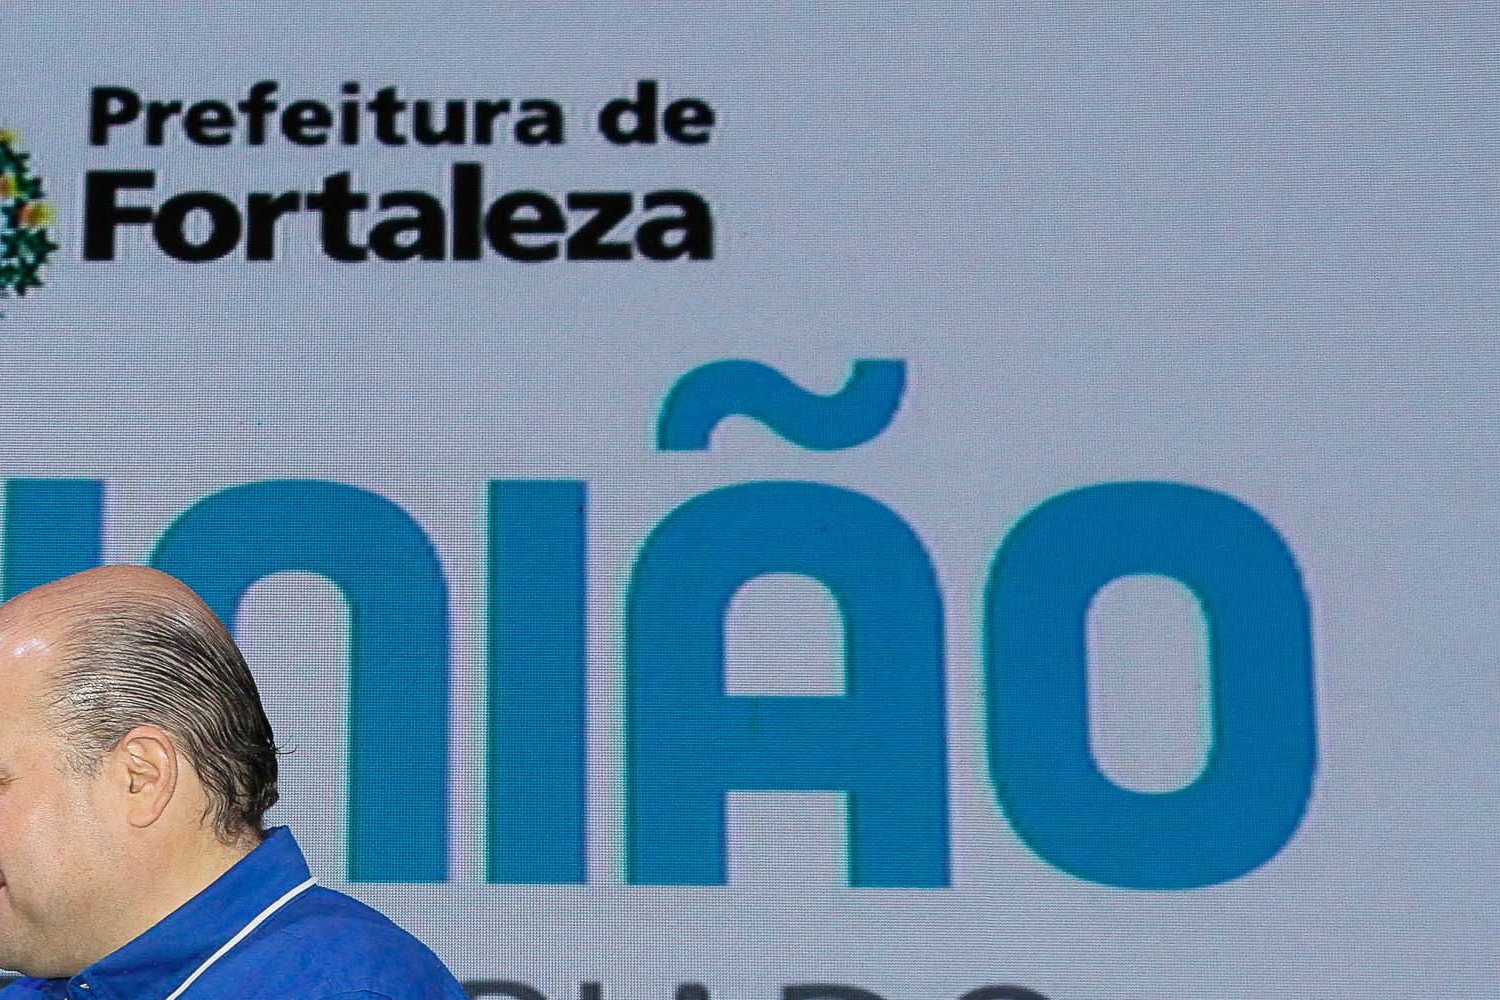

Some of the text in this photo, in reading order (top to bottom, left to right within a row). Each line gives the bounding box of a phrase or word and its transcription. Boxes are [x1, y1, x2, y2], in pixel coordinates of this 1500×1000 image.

[89, 79, 716, 148] Prefeitura de
[82, 161, 716, 263] Fortaleza
